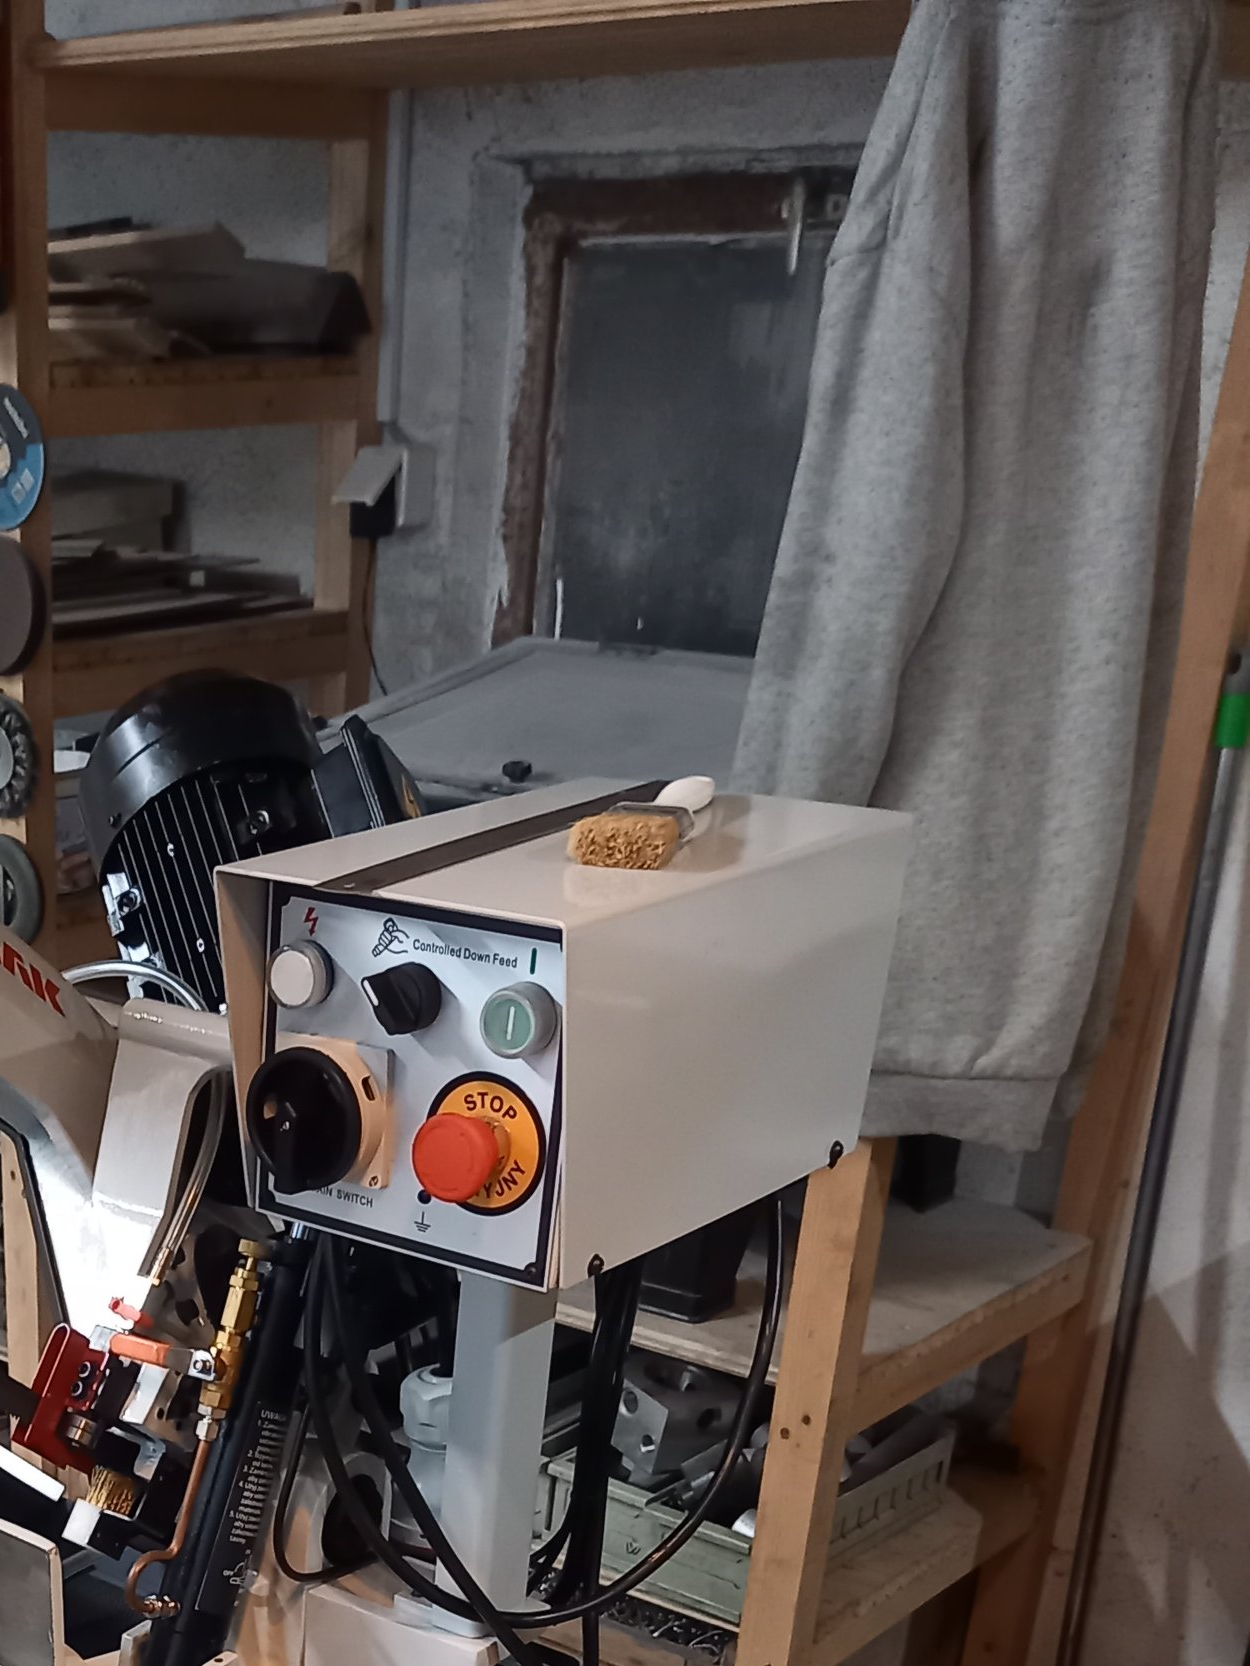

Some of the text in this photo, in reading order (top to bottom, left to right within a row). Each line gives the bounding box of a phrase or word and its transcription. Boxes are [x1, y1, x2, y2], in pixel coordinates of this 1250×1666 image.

[413, 939, 518, 969] Controlled Down Feed
[463, 1091, 518, 1120] STOP
[313, 1186, 373, 1208] AIN SWITCH
